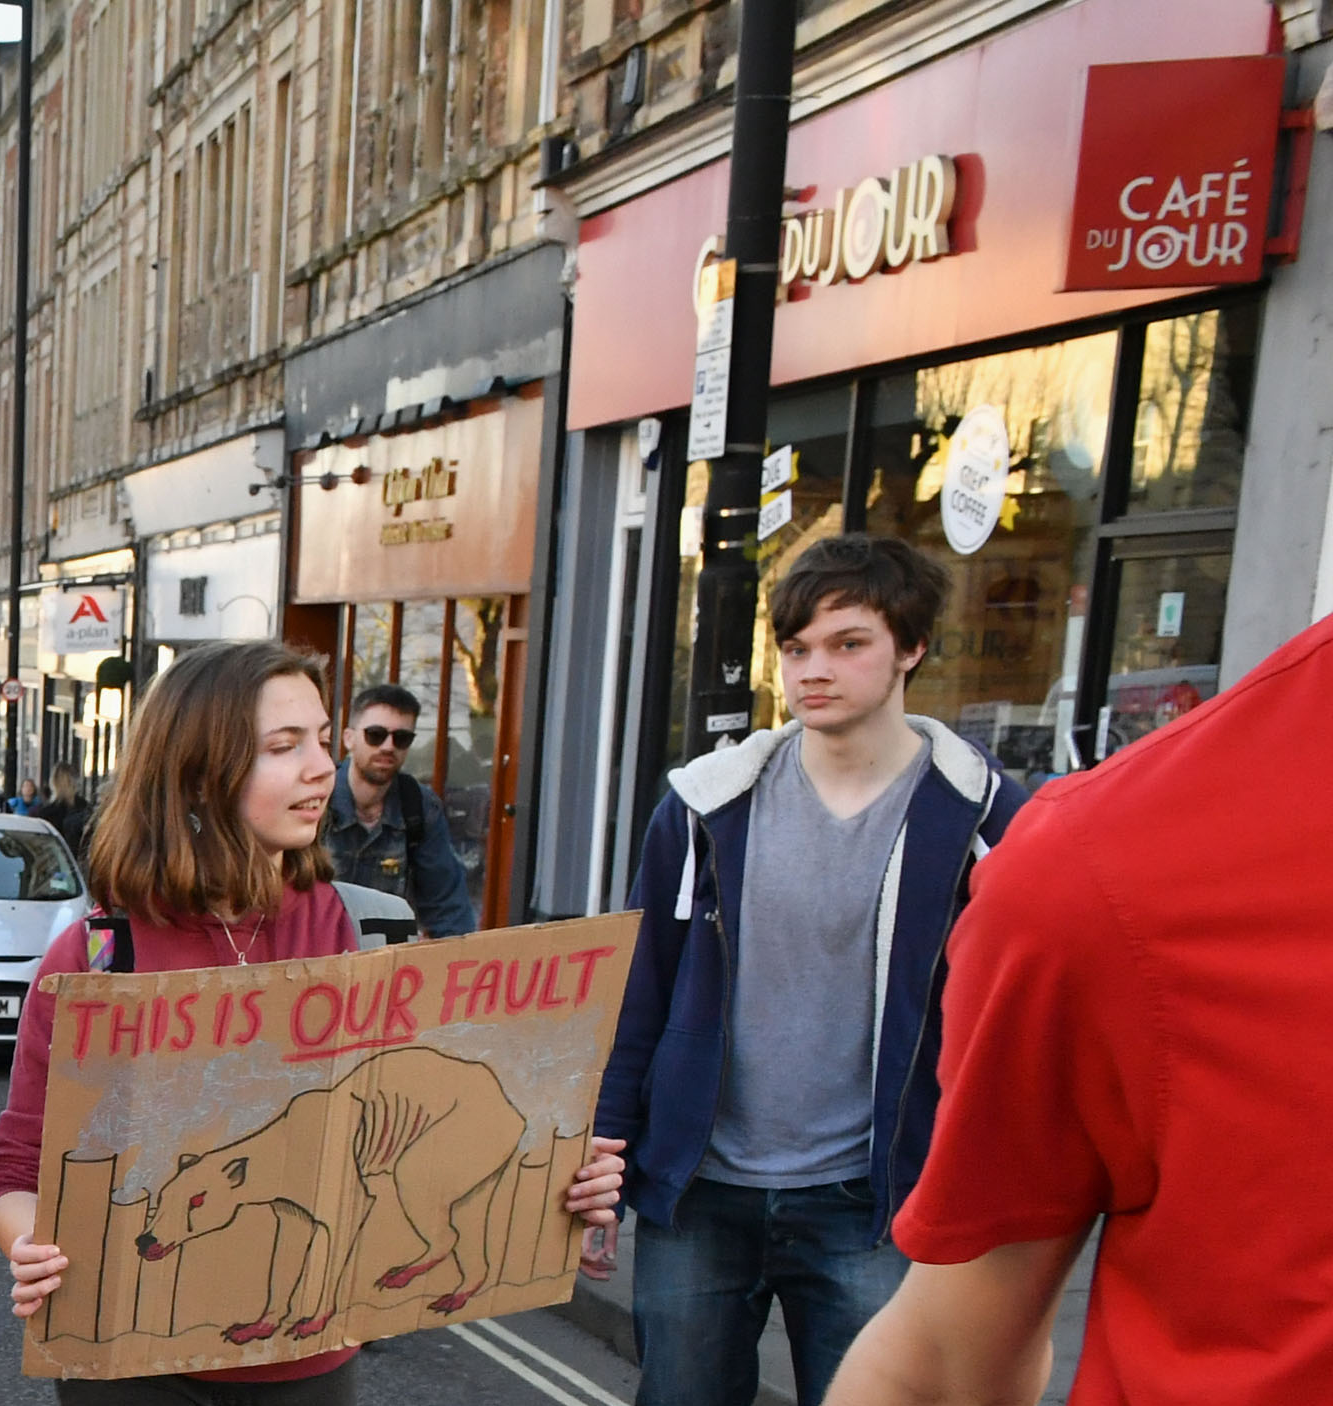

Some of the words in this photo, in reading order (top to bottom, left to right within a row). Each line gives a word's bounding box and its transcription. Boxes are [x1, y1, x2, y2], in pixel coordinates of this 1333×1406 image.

[783, 216, 825, 285] DU
[819, 154, 949, 287] JOUR
[1119, 158, 1252, 222] CAFÉ
[1086, 228, 1118, 250] DU
[1107, 221, 1248, 272] JOUR
[69, 993, 199, 1064] THIS
[214, 990, 265, 1049] IS
[290, 964, 423, 1049] OUR
[440, 946, 616, 1025] FAULT
